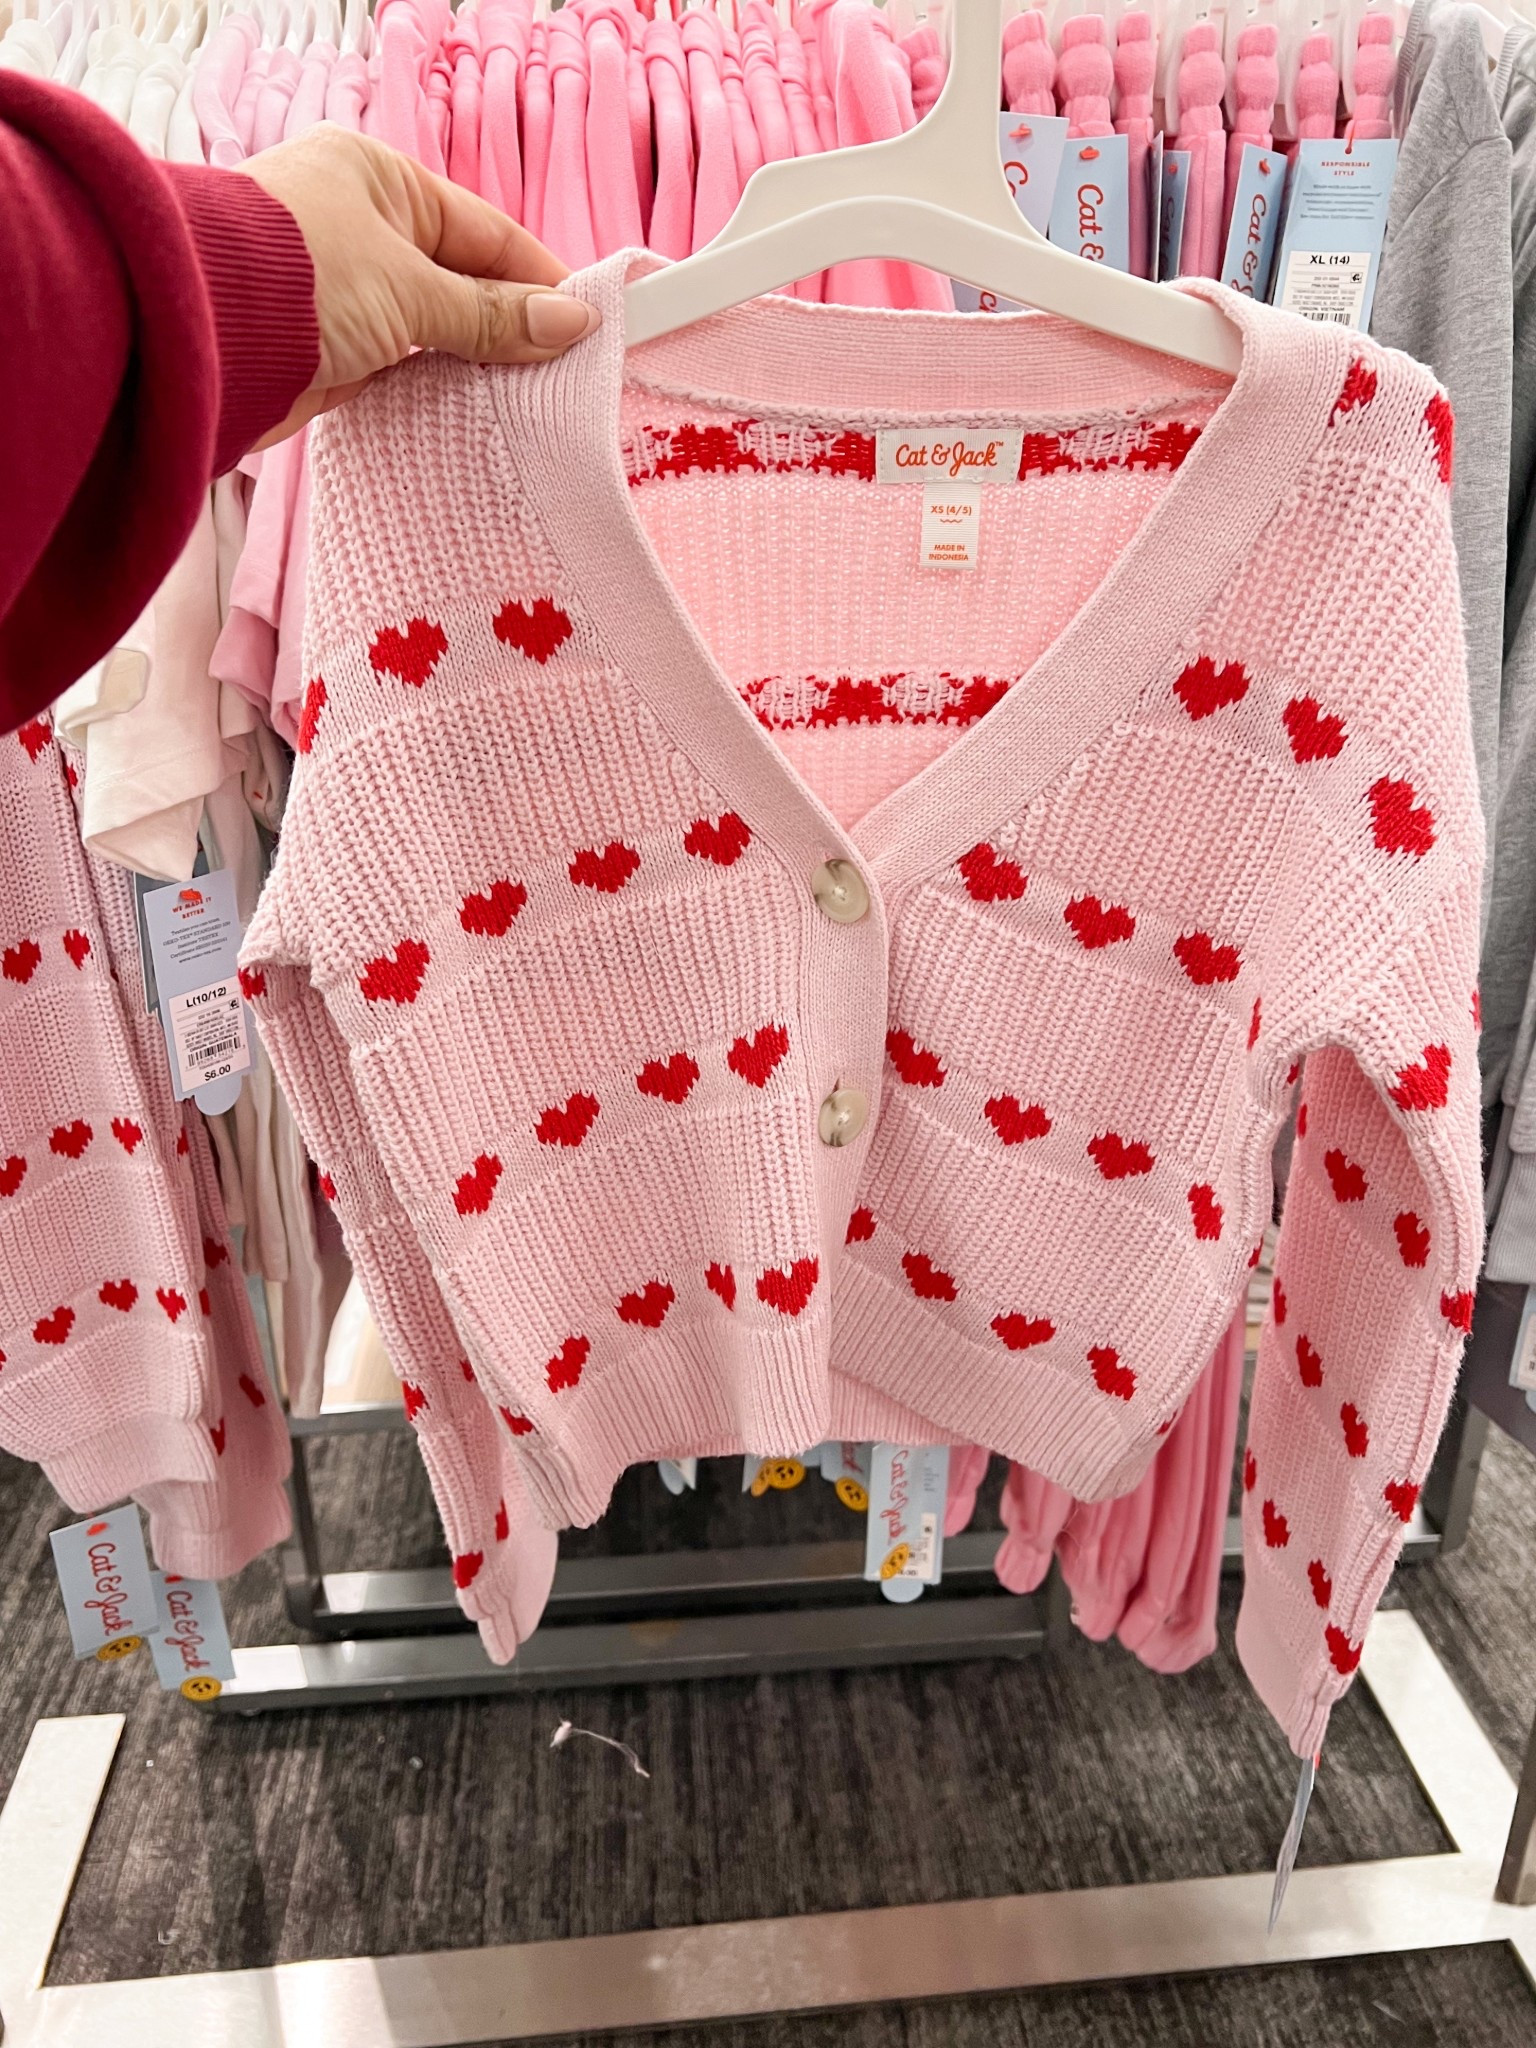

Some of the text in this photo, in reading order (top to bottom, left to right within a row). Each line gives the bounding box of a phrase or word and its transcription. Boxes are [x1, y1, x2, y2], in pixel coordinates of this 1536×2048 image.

[1078, 184, 1104, 238] Cat
[1248, 194, 1266, 244] Cat
[1242, 250, 1258, 280] &
[1310, 255, 1350, 264] XL (14)
[896, 444, 928, 467] Cat
[931, 444, 950, 466] &
[930, 505, 972, 516] XS (4/5)
[182, 908, 204, 919] BETTER
[185, 900, 203, 909] MADE
[186, 987, 227, 1007] L(10/12)
[204, 1064, 231, 1081] $6.00
[84, 1542, 133, 1636] Cat & Jack
[164, 1590, 210, 1672] Cat & Jack
